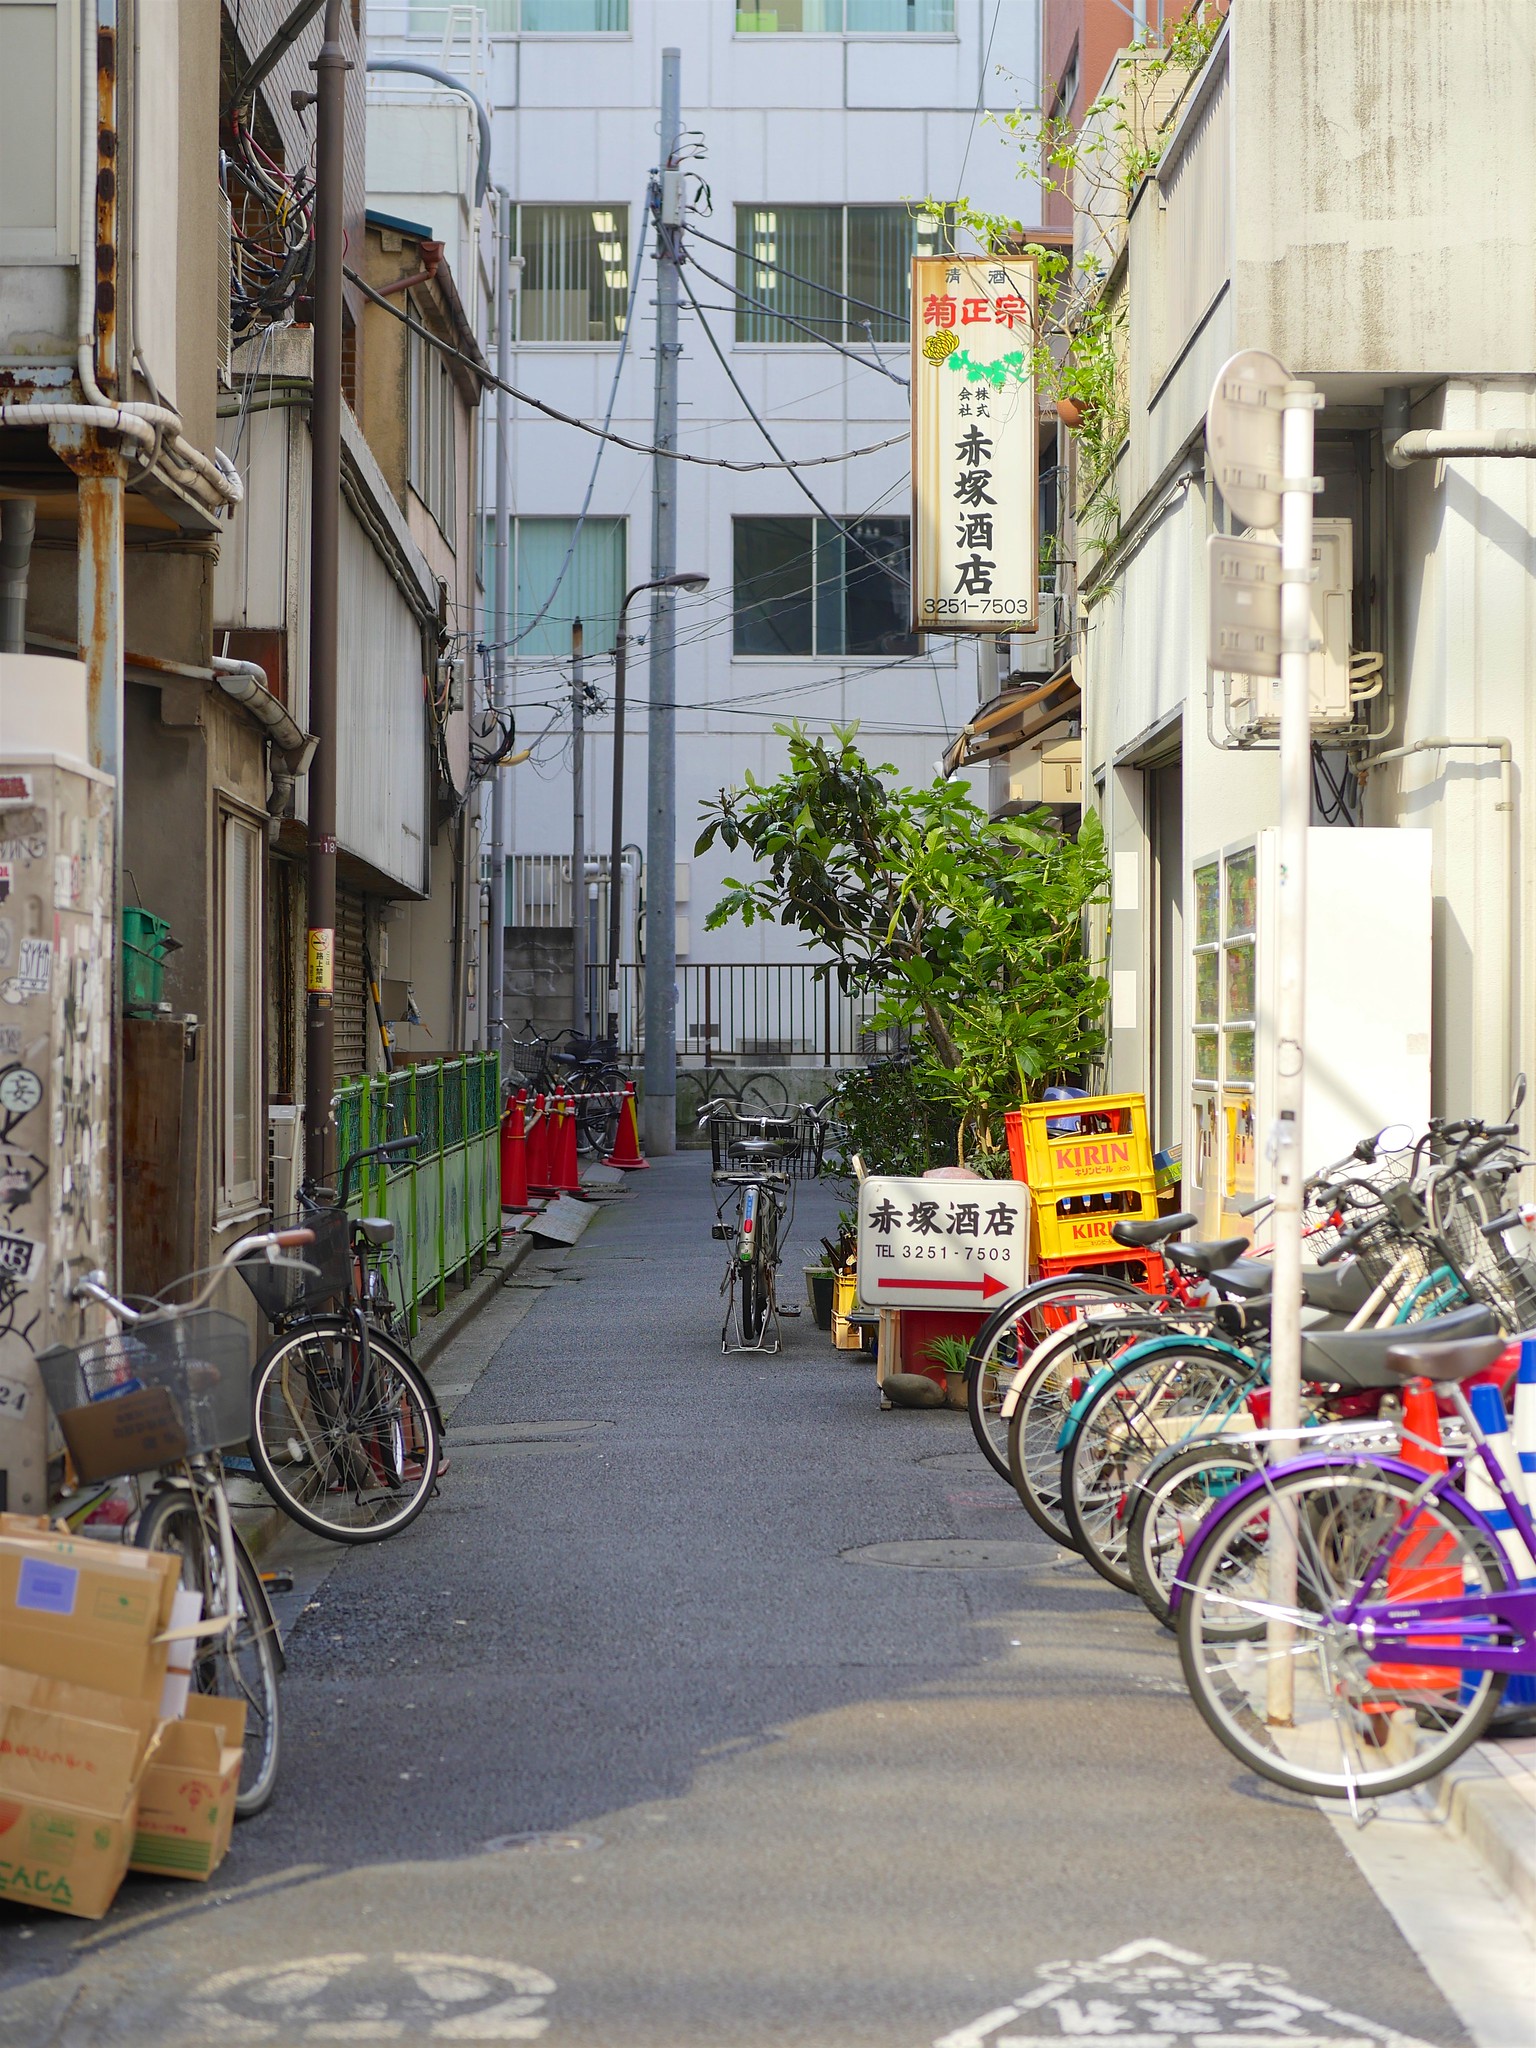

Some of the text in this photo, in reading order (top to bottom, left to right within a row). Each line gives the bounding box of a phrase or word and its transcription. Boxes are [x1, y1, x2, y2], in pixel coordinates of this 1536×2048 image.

[922, 293, 1027, 330] 菊正宗
[953, 424, 998, 596] 赤塚酒店
[923, 598, 1028, 615] 3251-7503
[1055, 1142, 1129, 1169] KIRIN
[1075, 1165, 1114, 1177] キリンビール
[868, 1197, 1018, 1238] 赤塚酒店
[1072, 1220, 1118, 1240] KIRI
[875, 1244, 895, 1258] TEL
